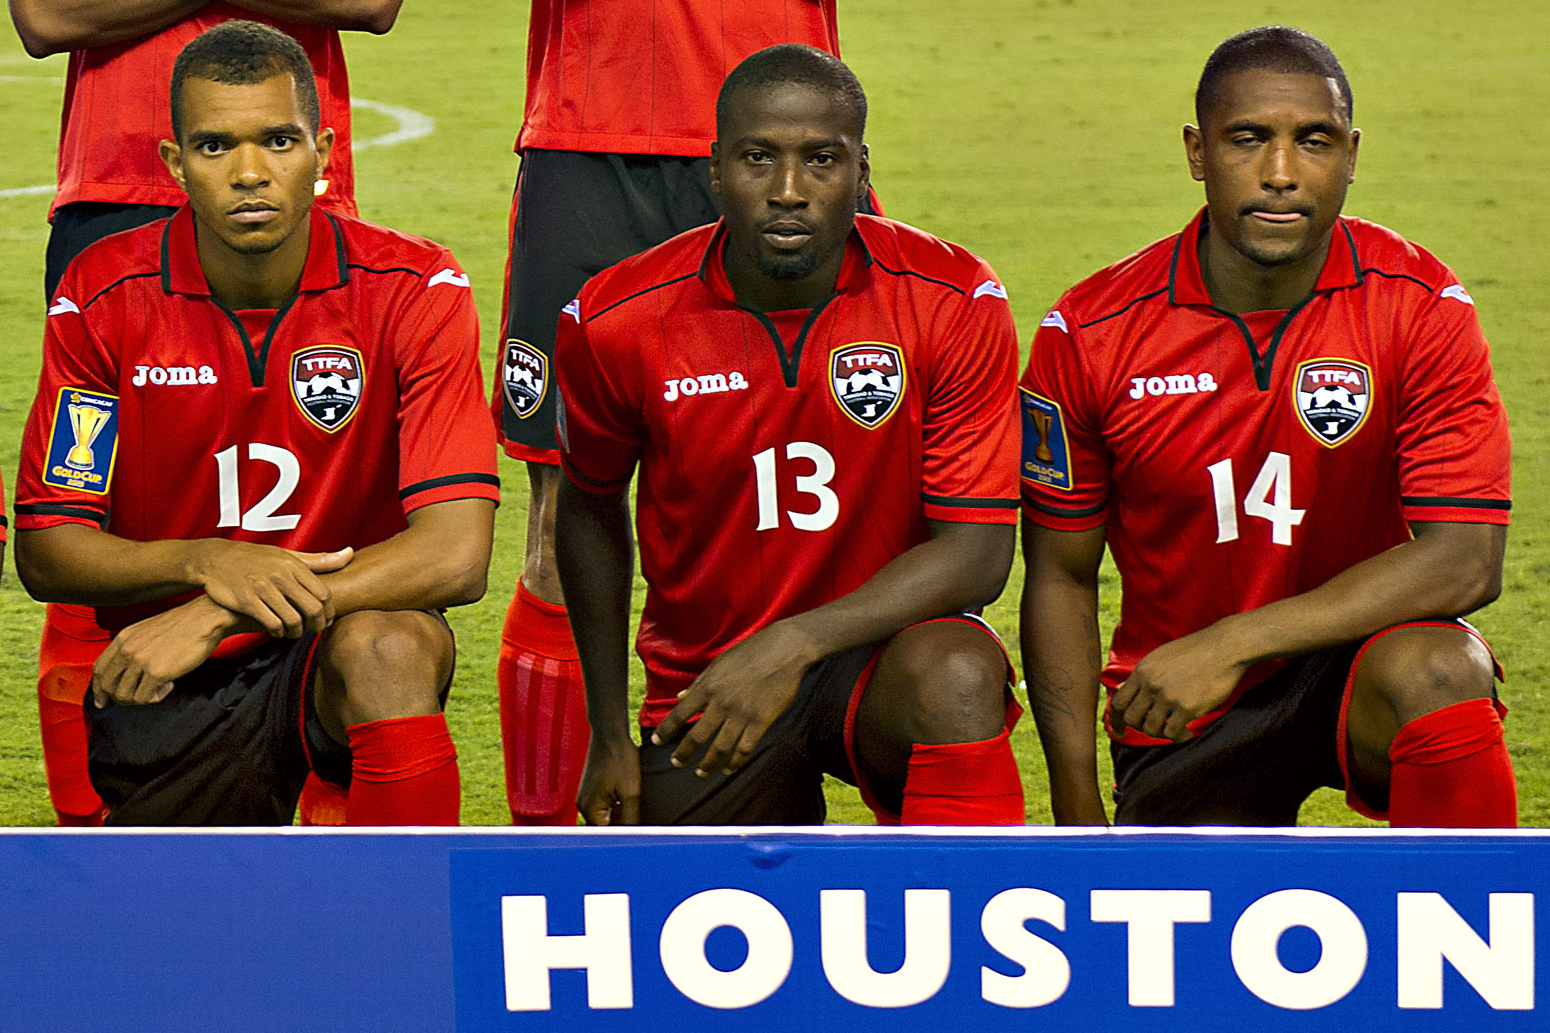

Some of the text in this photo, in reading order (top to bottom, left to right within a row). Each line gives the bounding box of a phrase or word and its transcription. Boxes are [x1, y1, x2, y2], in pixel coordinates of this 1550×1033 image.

[302, 357, 353, 370] TTFA
[511, 349, 540, 371] TTFA
[841, 353, 893, 367] TTFA
[132, 364, 217, 387] Joma
[663, 371, 748, 402] Joma
[1129, 372, 1217, 400] Joma
[1307, 370, 1361, 385] TTFA
[214, 443, 302, 532] 12
[752, 441, 840, 532] 13
[1207, 451, 1306, 546] 14
[501, 887, 1535, 1011] HOUSTON
